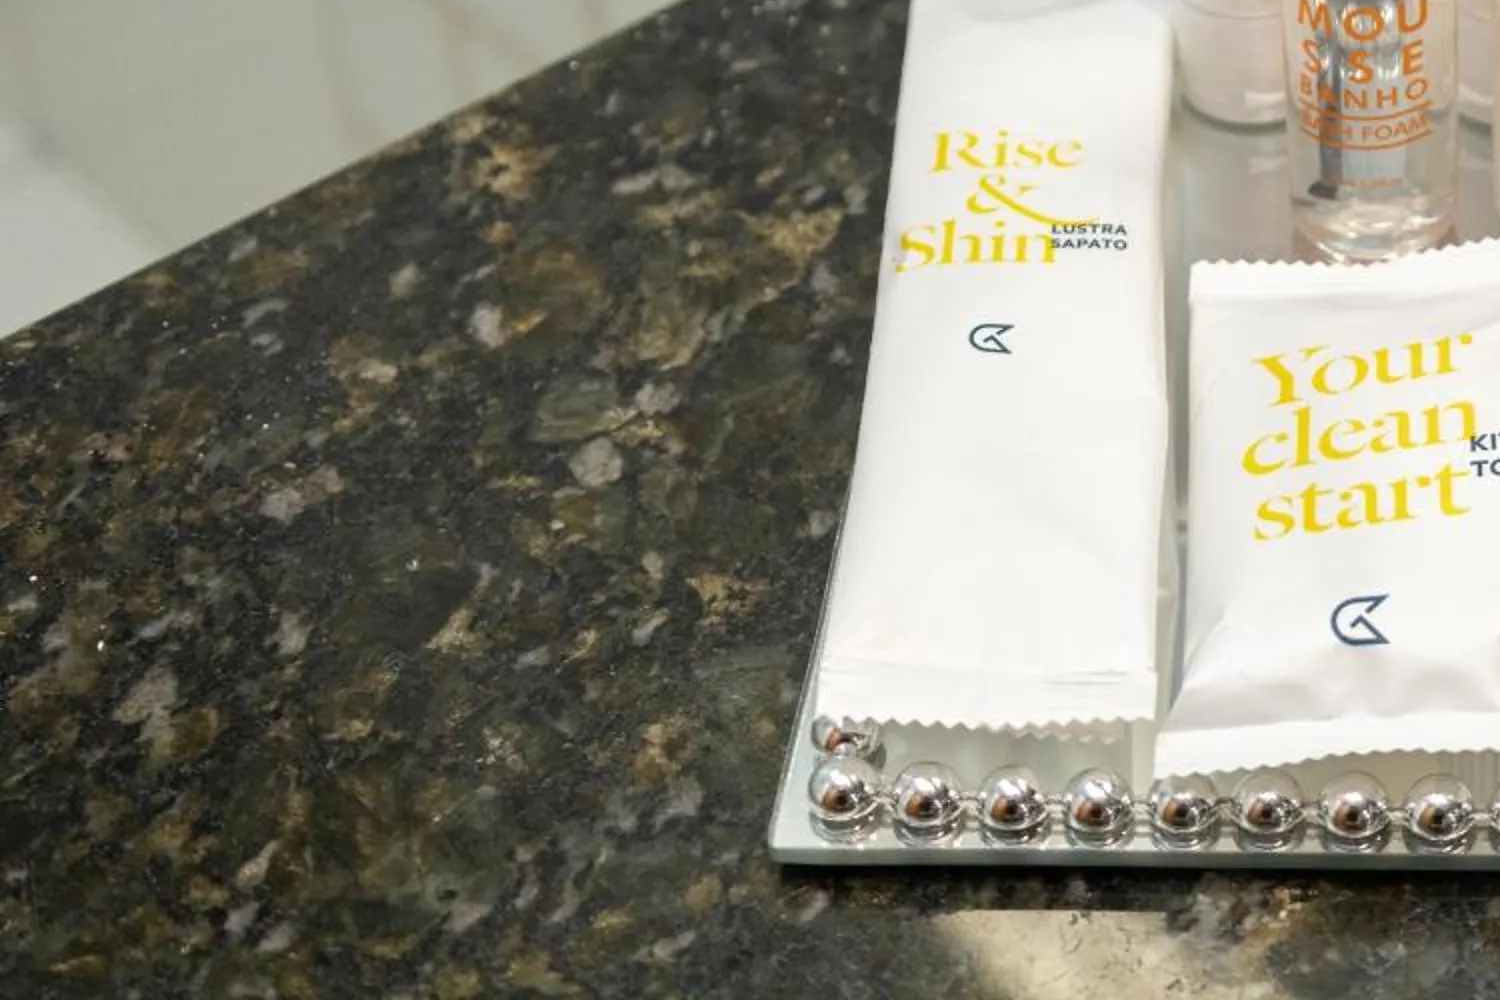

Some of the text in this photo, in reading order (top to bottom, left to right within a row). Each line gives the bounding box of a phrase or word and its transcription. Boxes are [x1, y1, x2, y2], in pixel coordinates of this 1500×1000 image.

[928, 129, 1084, 174] Rise
[894, 218, 1057, 273] Shin
[1050, 223, 1128, 236] LUSTRA
[1050, 237, 1128, 250] SAPATO
[1251, 331, 1473, 407] Your
[1241, 400, 1479, 476] clean
[1253, 462, 1473, 541] start
